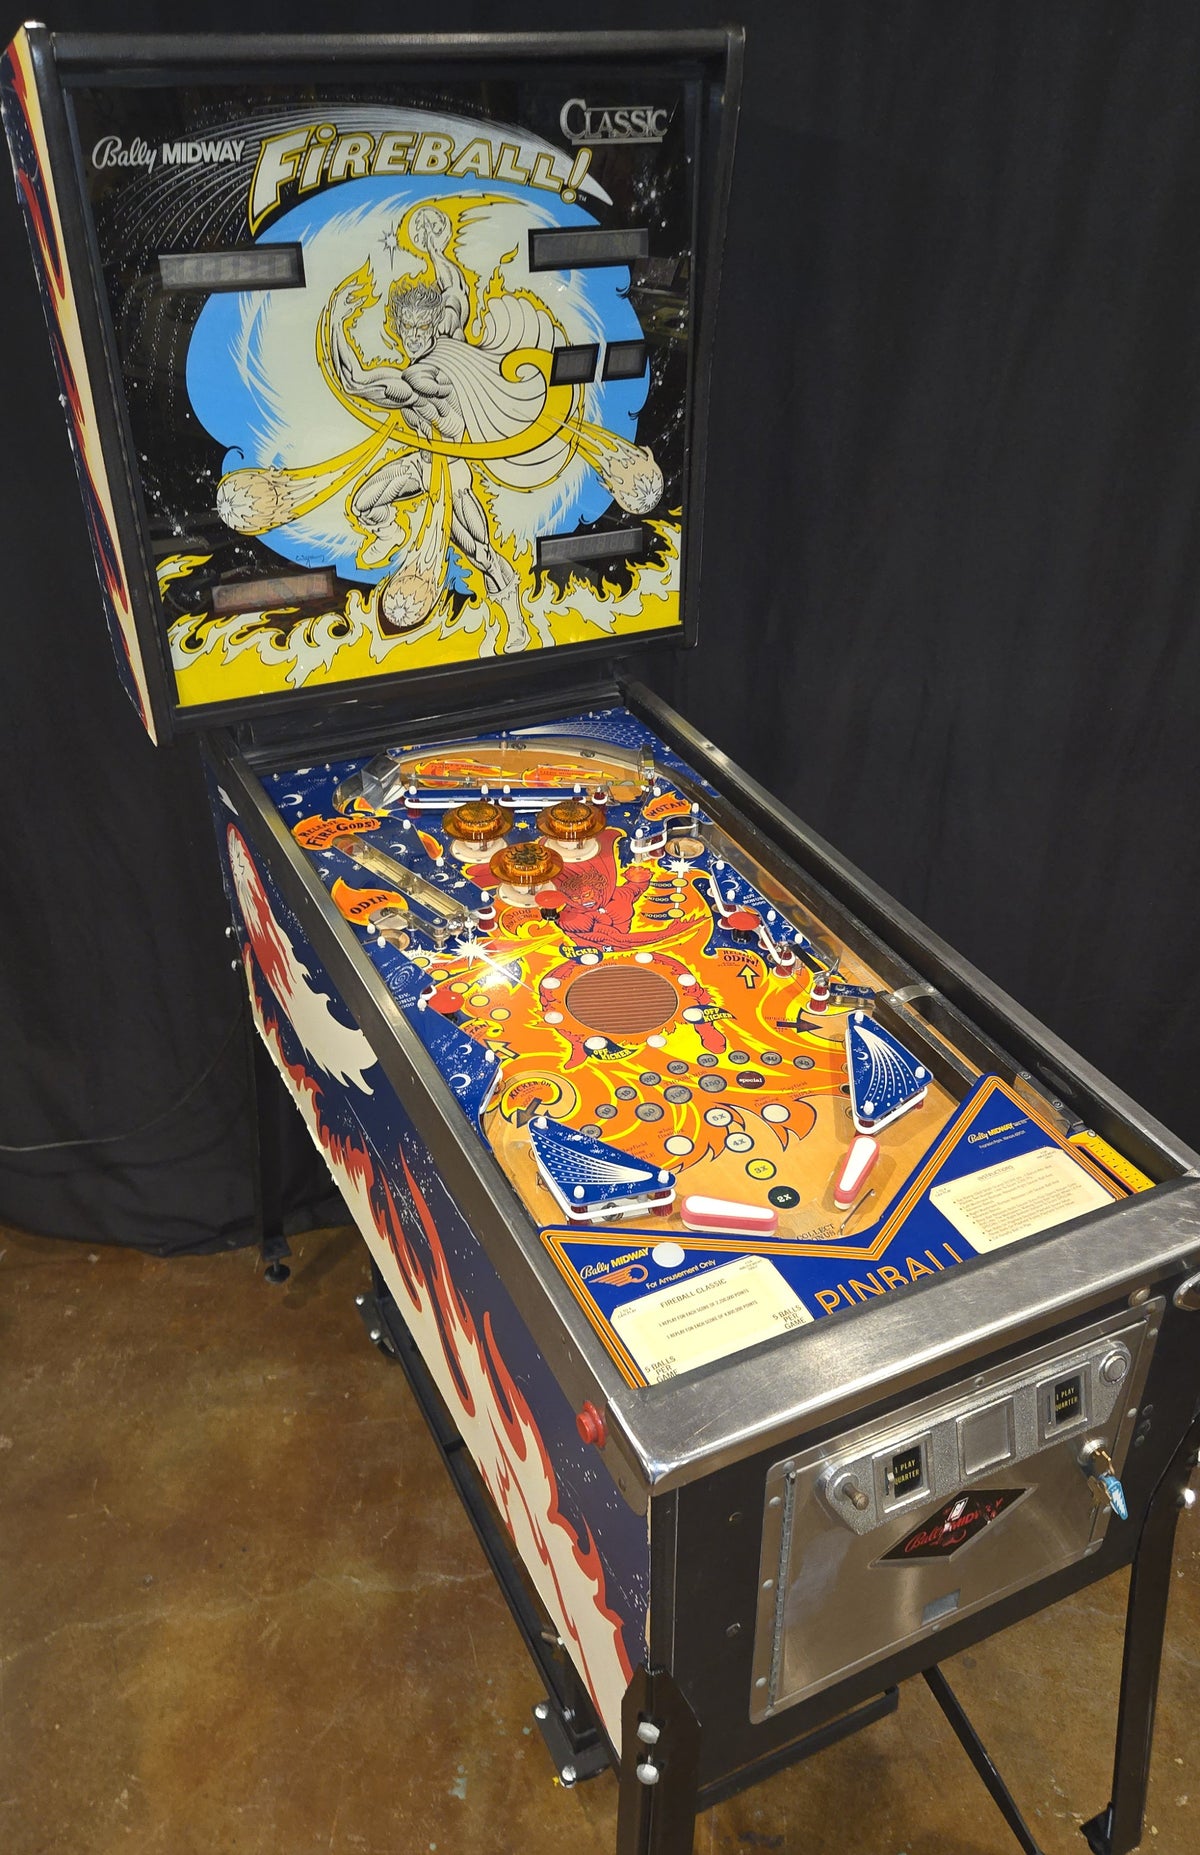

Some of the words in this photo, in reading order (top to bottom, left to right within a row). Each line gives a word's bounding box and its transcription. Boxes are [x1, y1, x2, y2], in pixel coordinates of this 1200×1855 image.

[92, 135, 156, 173] Bally
[162, 140, 245, 165] MIDWAY
[647, 801, 687, 817] WOTAN
[350, 894, 389, 915] ODIN
[563, 948, 598, 958] KICKER
[601, 1049, 632, 1060] KICKER
[670, 1089, 687, 1100] 100
[602, 1107, 612, 1115] 10
[580, 1261, 610, 1279] Bally
[610, 1247, 649, 1268] MIDWAY
[646, 1281, 658, 1290] For
[659, 1265, 699, 1285] Amusement
[699, 1259, 717, 1269] Only
[660, 1291, 696, 1308] FIREBALL
[696, 1278, 727, 1295] CLASSIC
[772, 1313, 779, 1321] 5
[778, 1304, 802, 1319] BALLS
[783, 1312, 799, 1323] PER
[784, 1317, 807, 1330] GAME
[651, 1355, 676, 1371] BALLS
[655, 1364, 672, 1375] PER
[900, 1459, 916, 1472] PLAY
[894, 1468, 920, 1486] QUARTER
